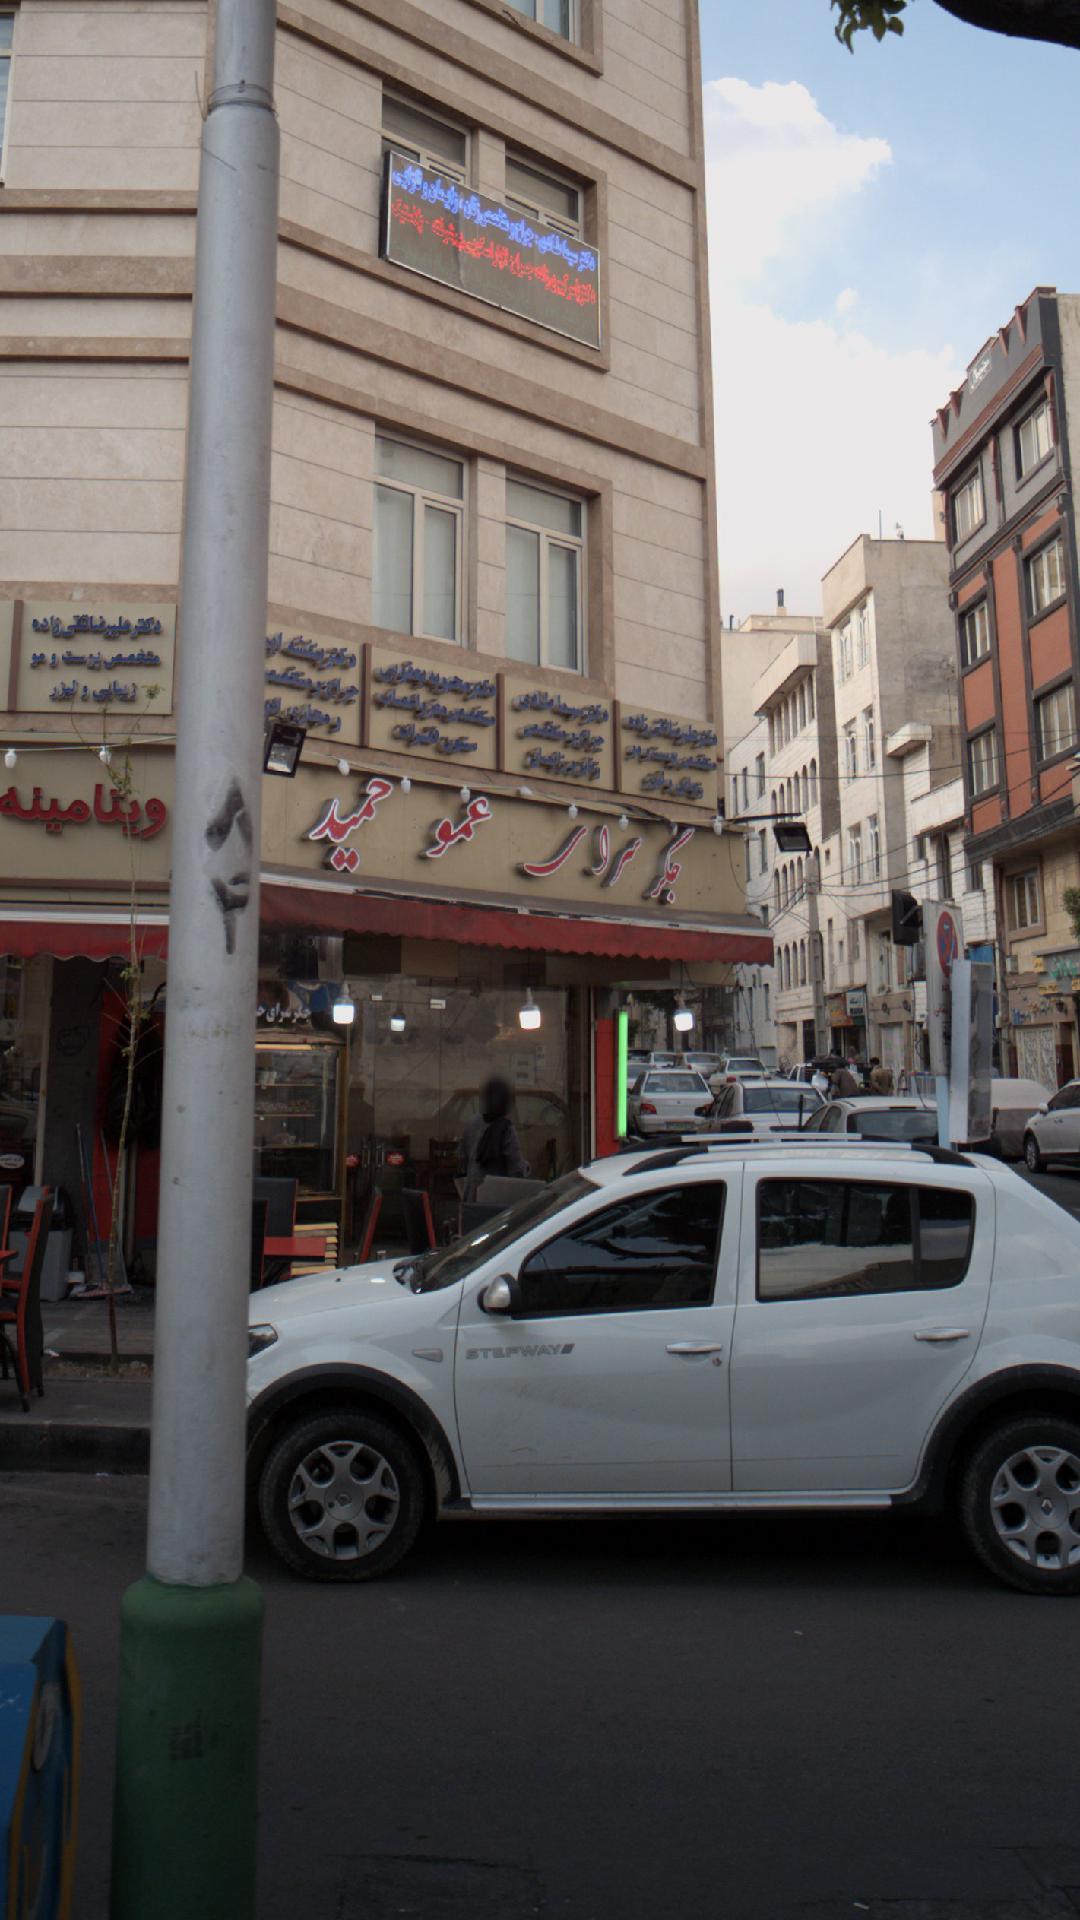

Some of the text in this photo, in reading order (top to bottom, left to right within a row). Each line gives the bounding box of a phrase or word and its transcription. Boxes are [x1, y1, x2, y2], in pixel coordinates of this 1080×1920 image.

[129, 616, 161, 639] دکتر
[30, 649, 161, 671] متخصص پوست و مو
[49, 679, 138, 702] زیبایی و لیزر
[0, 784, 167, 839] ویتامینه
[306, 776, 394, 874] حمید
[424, 796, 494, 859] عمو
[648, 826, 696, 905] جگر
[466, 1344, 563, 1360] STEPWAY
